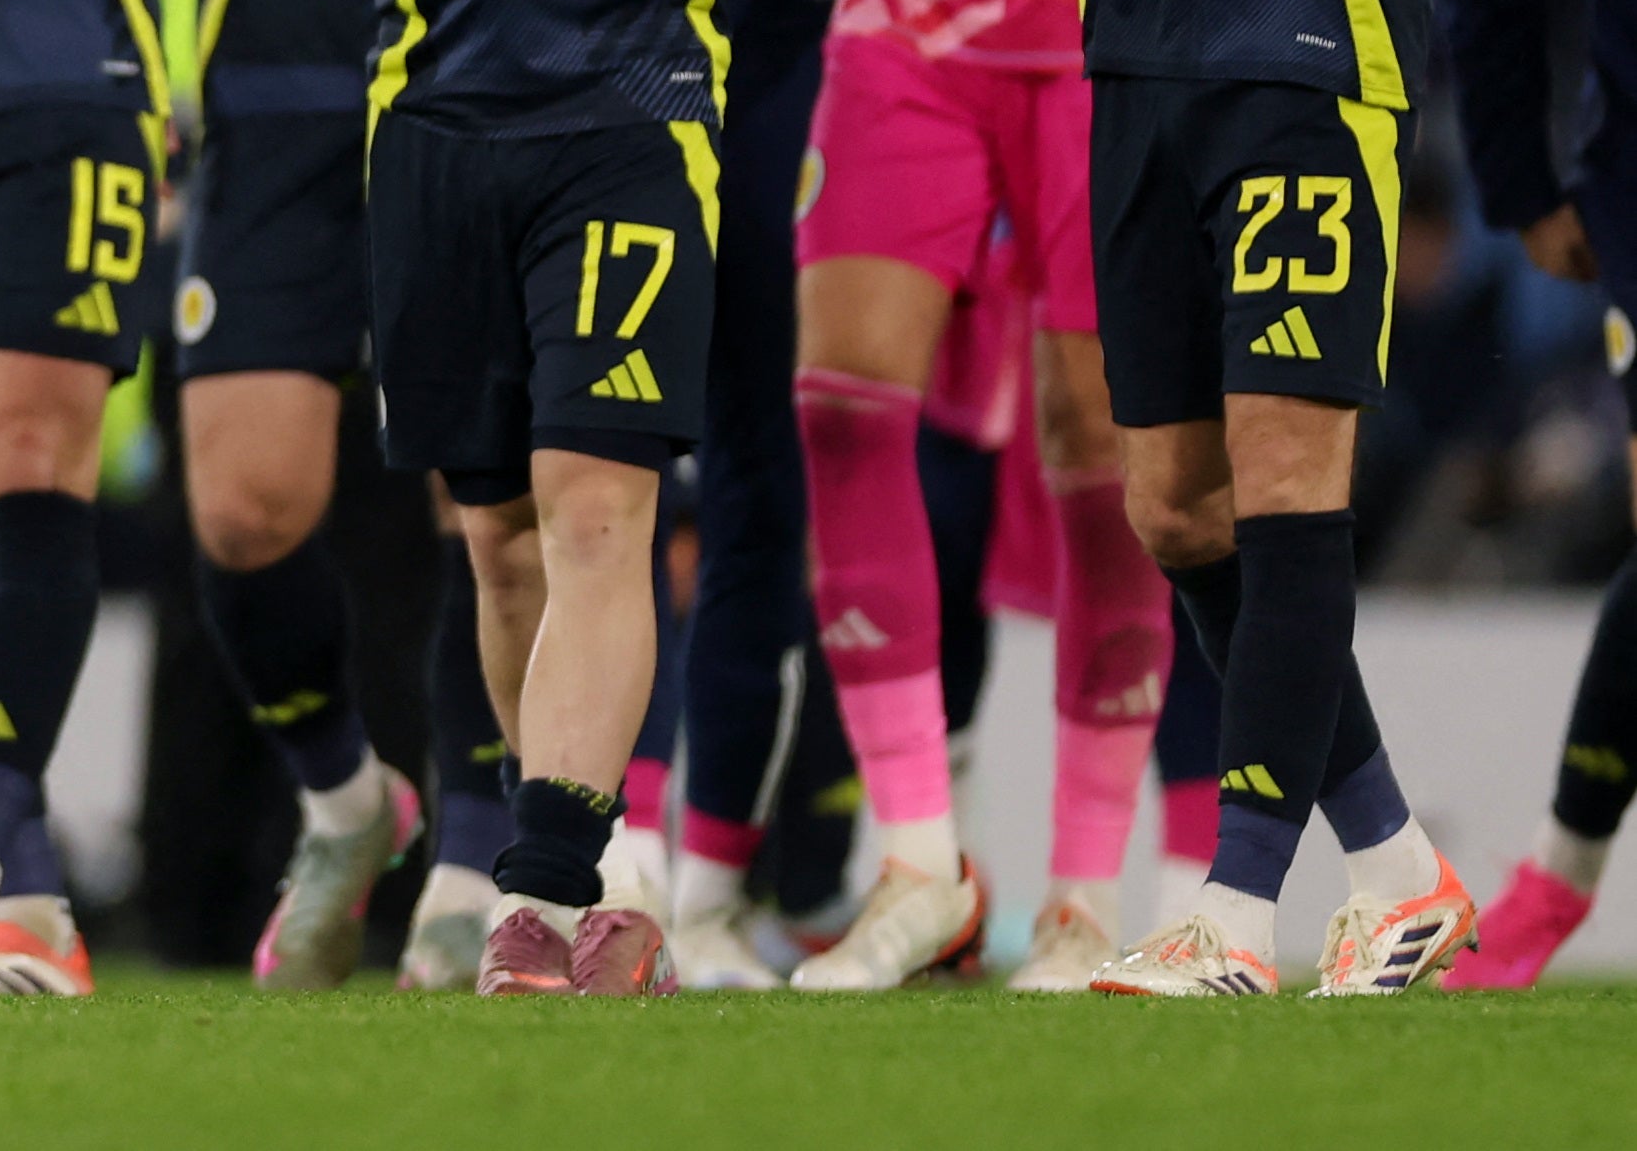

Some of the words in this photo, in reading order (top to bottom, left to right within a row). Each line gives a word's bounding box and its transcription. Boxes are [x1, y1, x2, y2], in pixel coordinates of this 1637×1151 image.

[66, 156, 146, 284] 15
[575, 219, 675, 340] 17
[1232, 175, 1352, 294] 23
